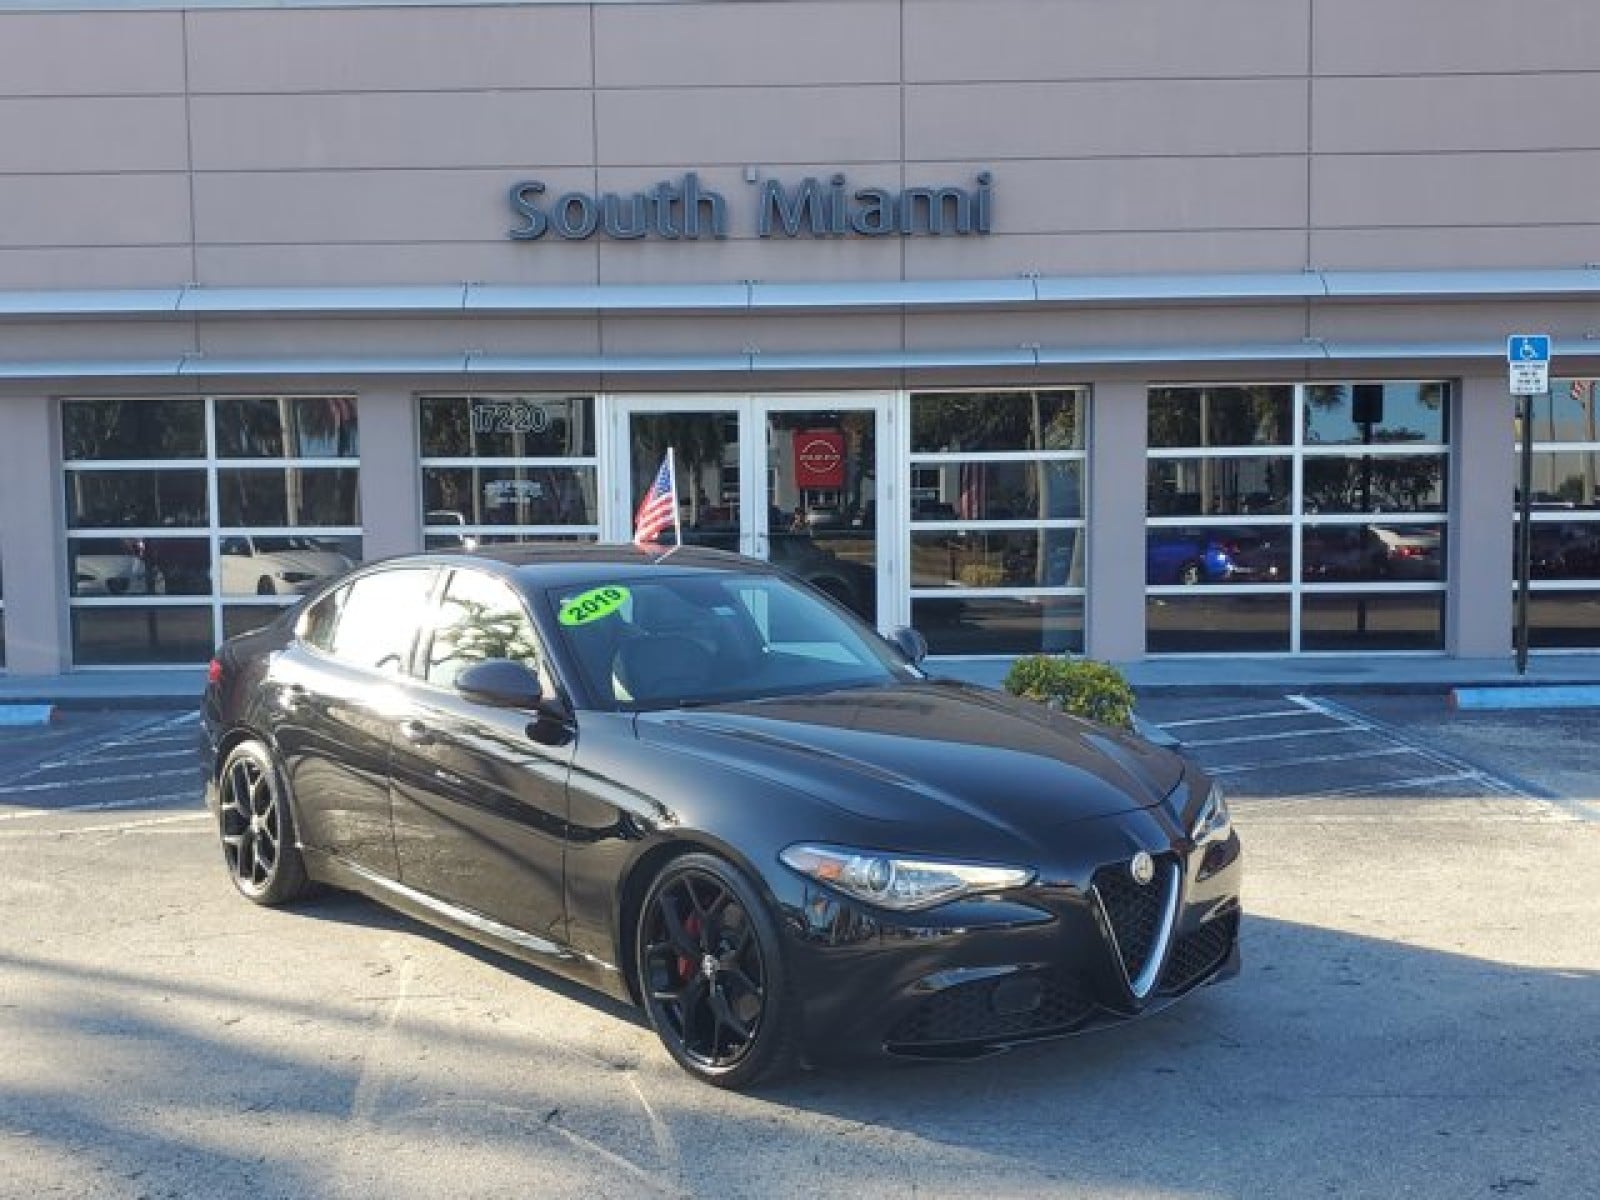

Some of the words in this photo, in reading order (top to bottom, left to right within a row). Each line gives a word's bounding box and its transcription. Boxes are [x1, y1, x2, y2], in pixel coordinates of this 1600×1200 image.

[508, 172, 727, 240] South
[759, 171, 992, 237] Miami
[471, 404, 549, 433] 17220
[567, 588, 621, 621] 2019
